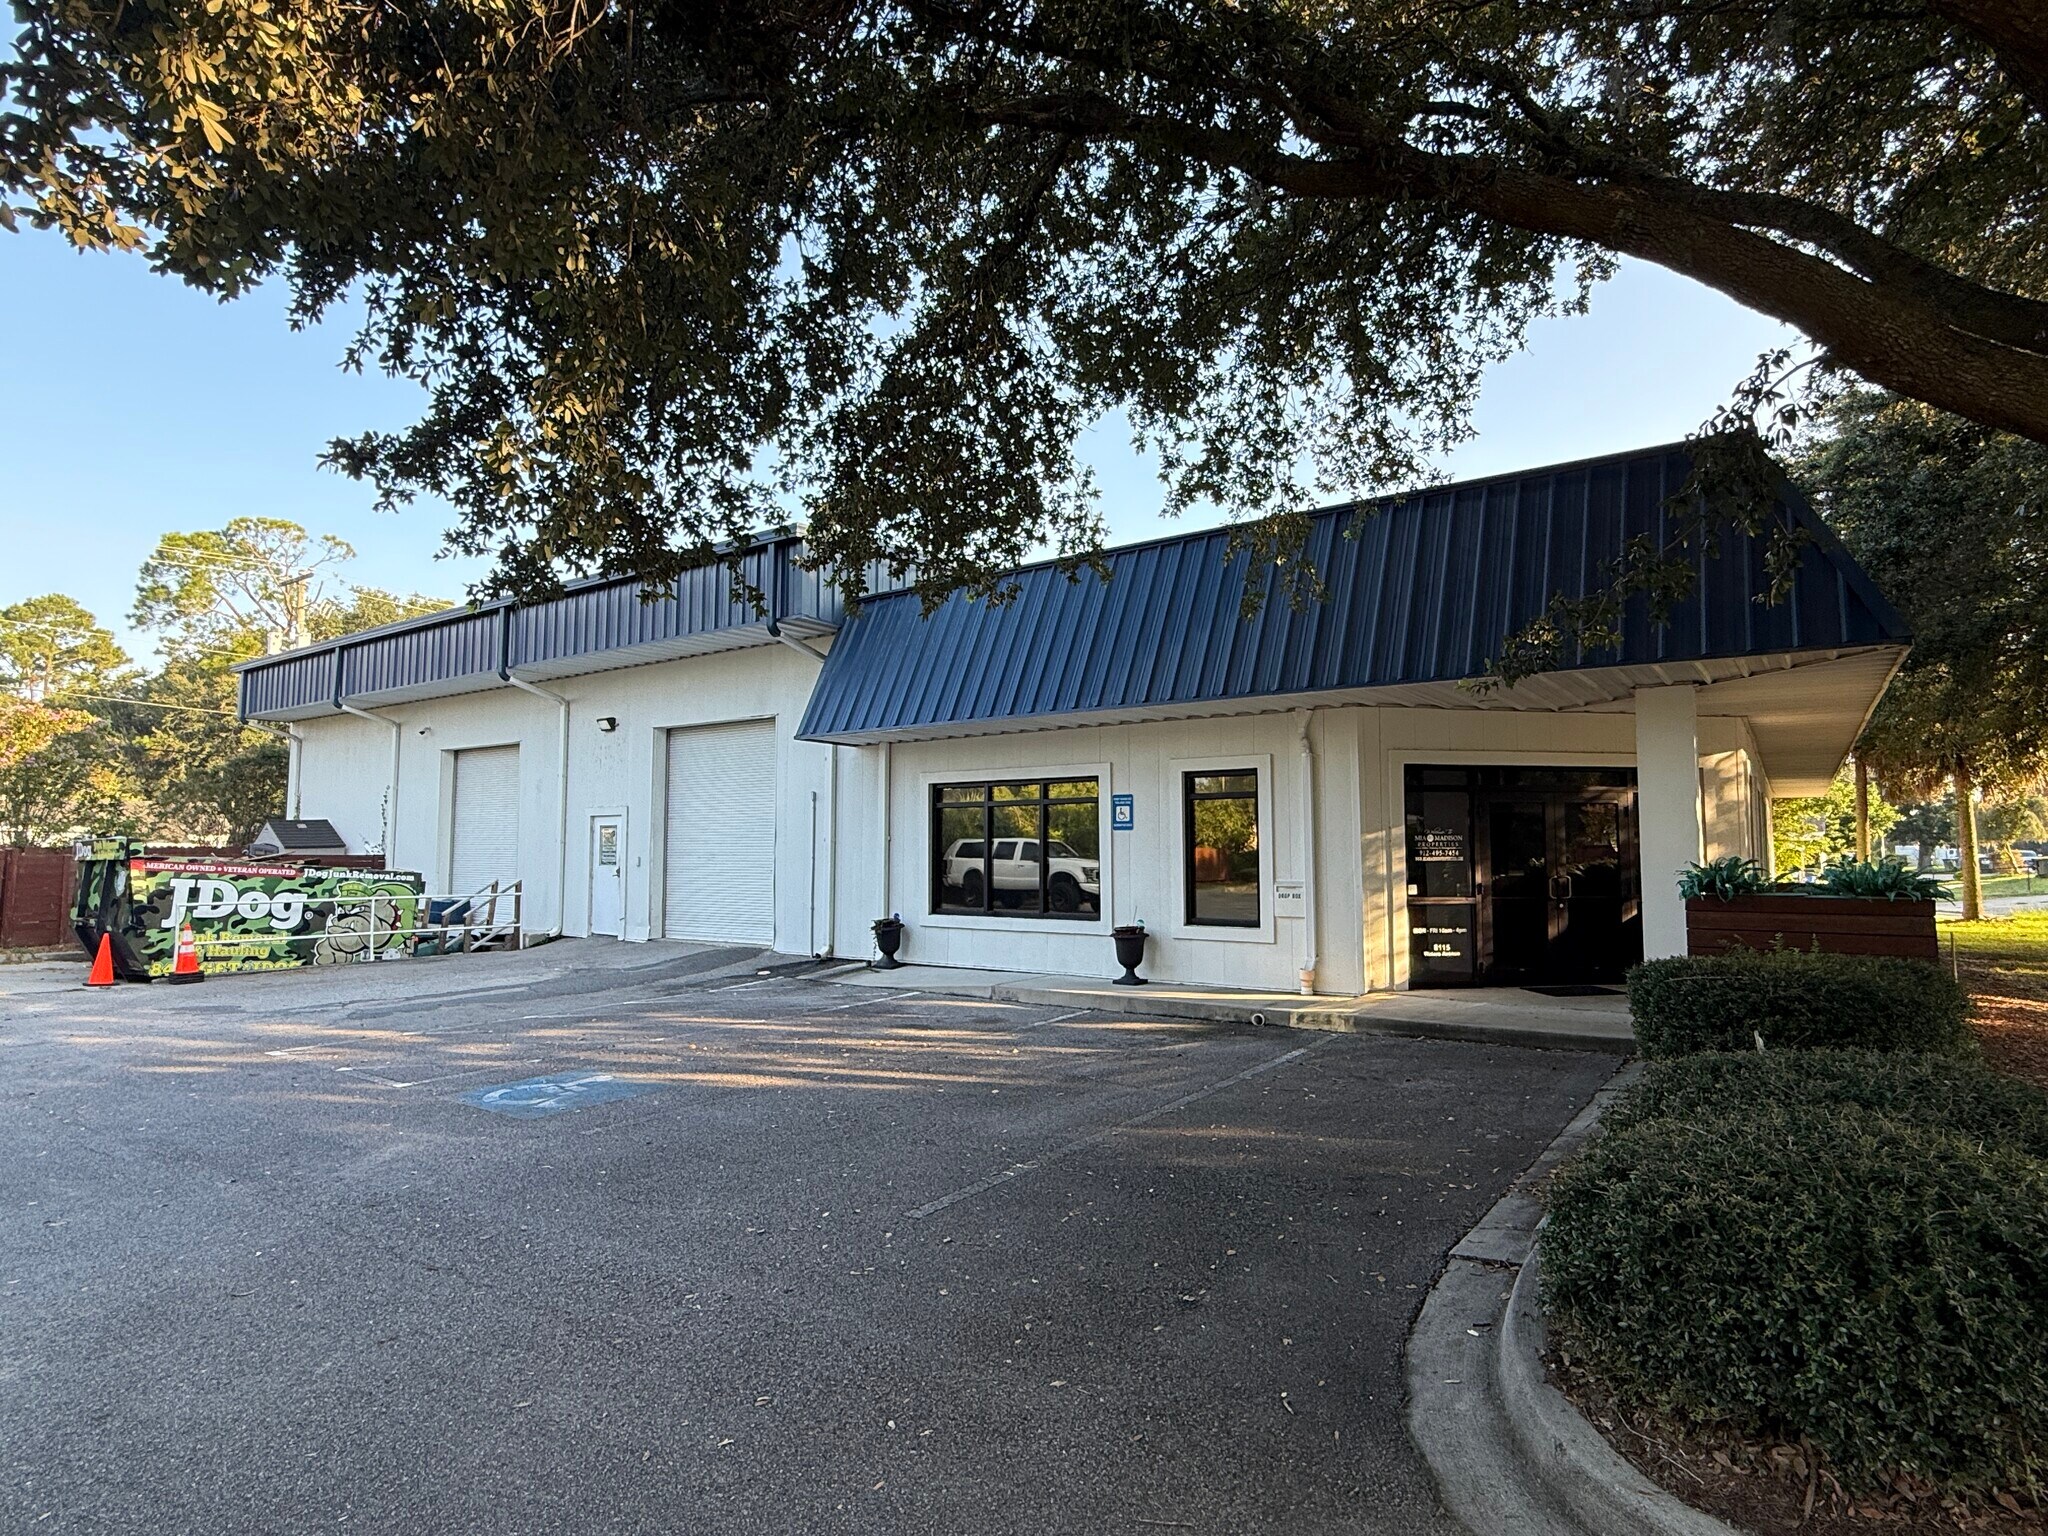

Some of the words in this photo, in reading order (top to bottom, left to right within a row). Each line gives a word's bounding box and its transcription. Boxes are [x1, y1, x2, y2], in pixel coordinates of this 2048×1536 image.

[222, 866, 258, 874] VETERAN
[258, 868, 297, 876] OPERATED
[303, 868, 415, 882] JDogJunkRemoval.com
[161, 878, 308, 930] JDog
[206, 944, 271, 958] Hauling
